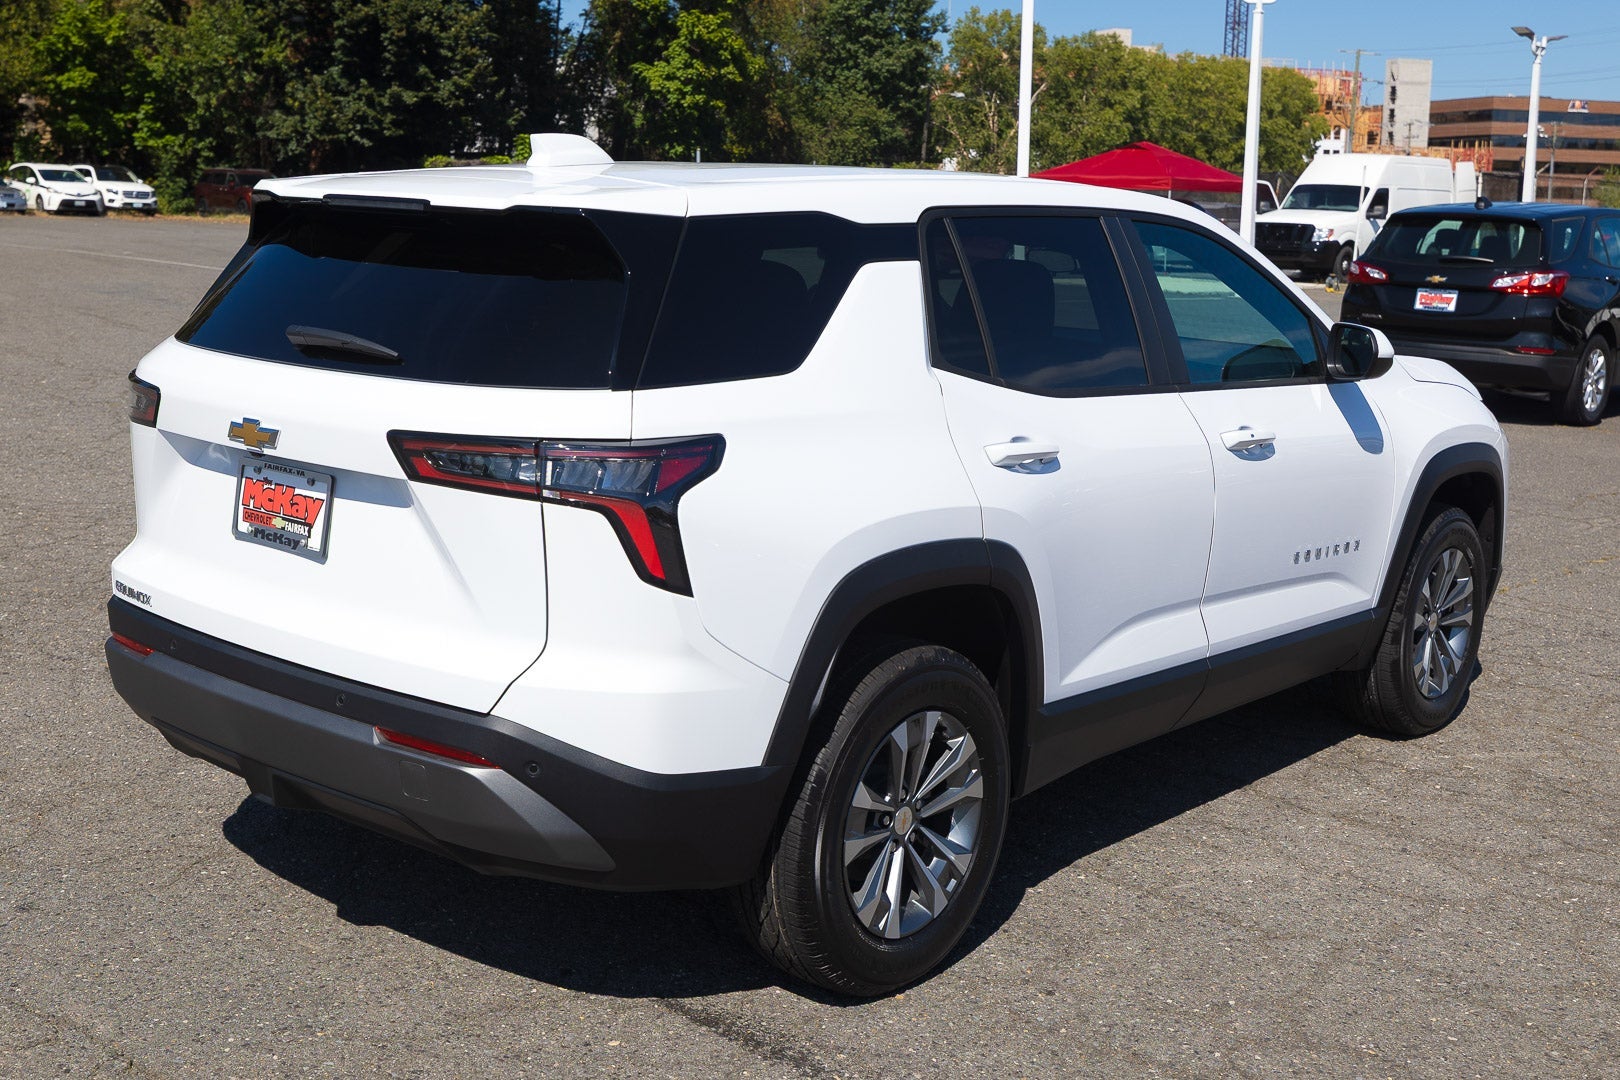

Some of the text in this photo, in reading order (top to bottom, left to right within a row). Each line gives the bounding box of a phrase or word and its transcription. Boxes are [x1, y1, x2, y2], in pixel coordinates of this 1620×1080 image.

[242, 477, 325, 529] McKay
[244, 511, 272, 526] CHEVROLET
[285, 522, 309, 537] FAIRFAX
[253, 527, 301, 550] McKay
[1292, 539, 1361, 564] EQUINOX
[113, 579, 152, 608] EQUINOX
